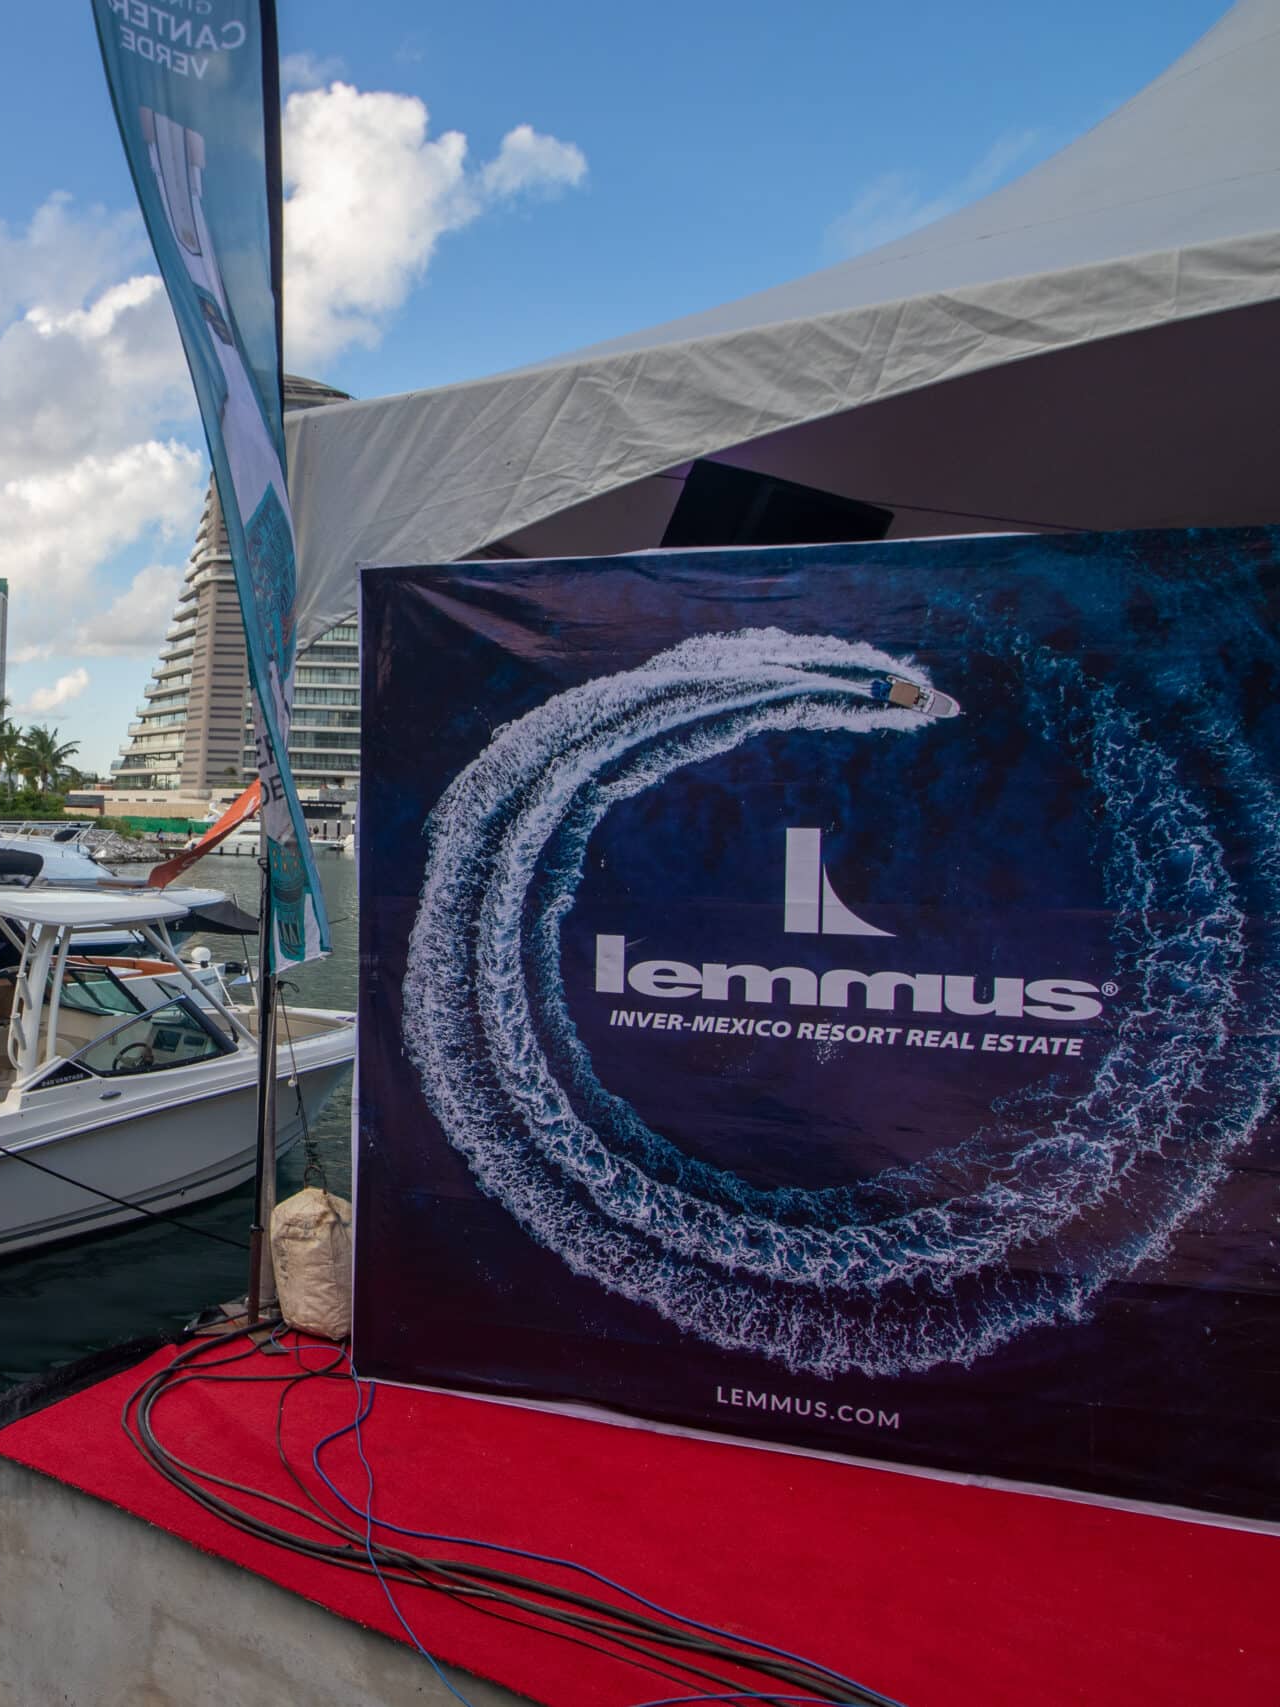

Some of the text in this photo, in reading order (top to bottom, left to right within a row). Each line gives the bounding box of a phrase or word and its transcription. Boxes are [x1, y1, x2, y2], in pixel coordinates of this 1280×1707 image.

[609, 1009, 1084, 1056] INVER-MEXICO RESORT REAL ESTATE
[716, 1386, 900, 1429] LEMMUS.COM
